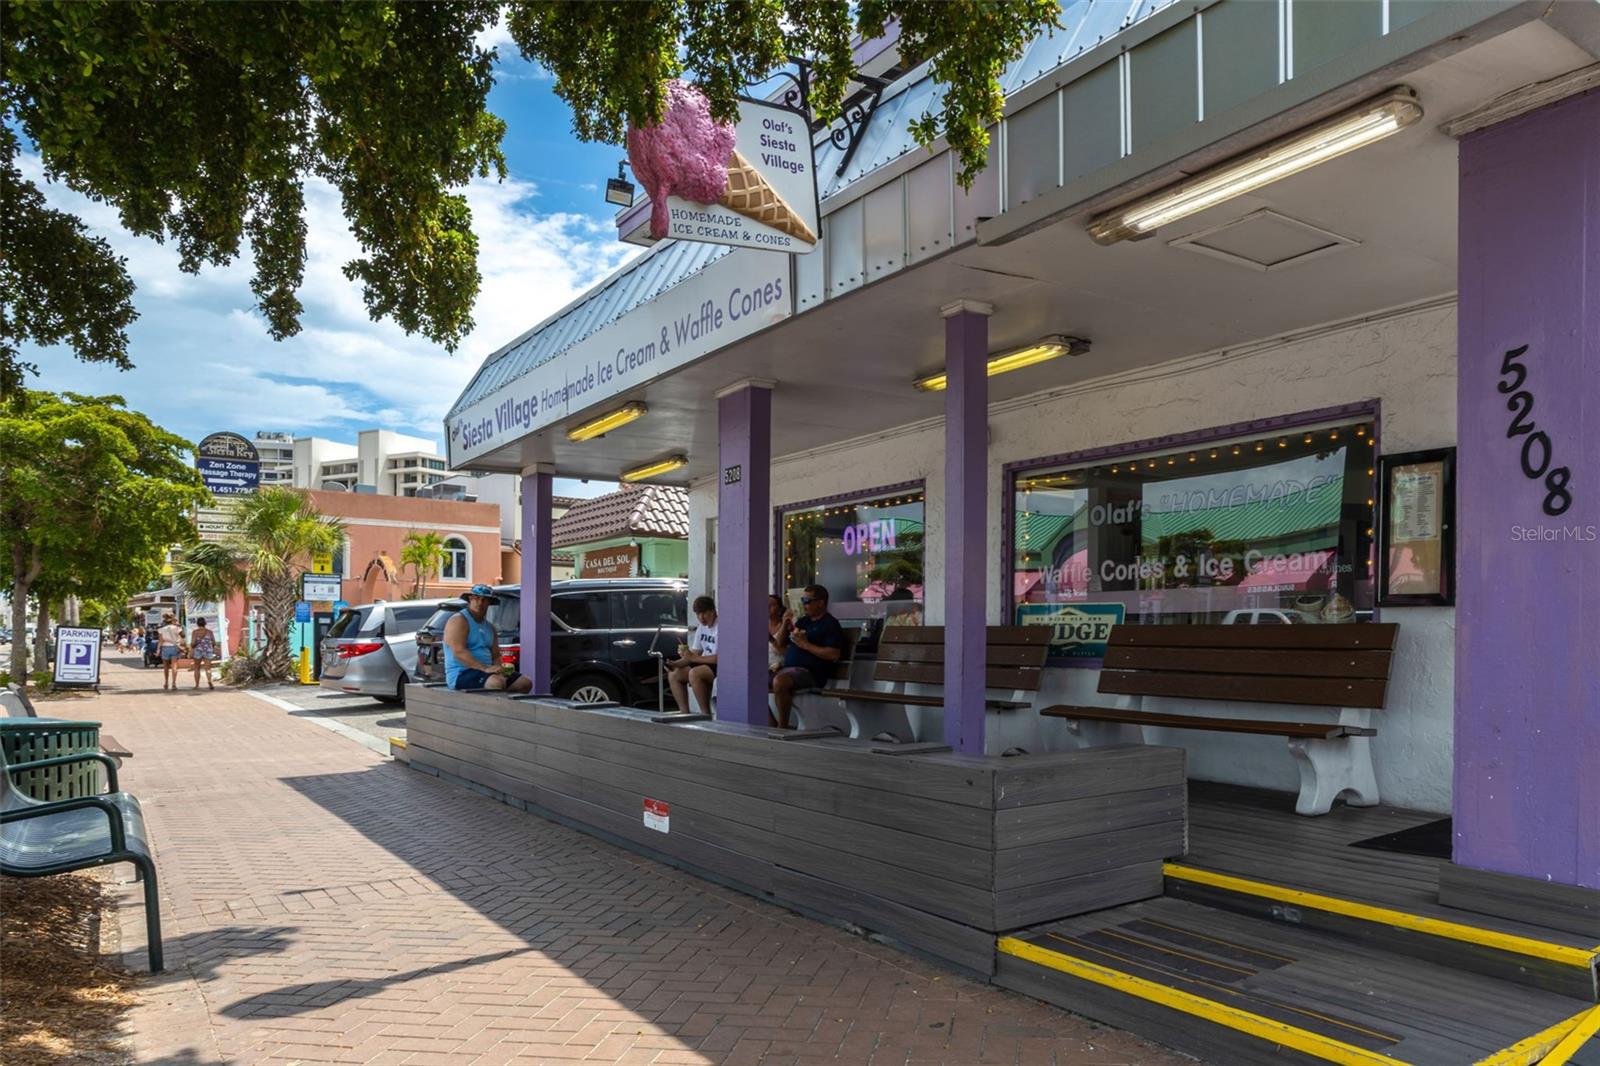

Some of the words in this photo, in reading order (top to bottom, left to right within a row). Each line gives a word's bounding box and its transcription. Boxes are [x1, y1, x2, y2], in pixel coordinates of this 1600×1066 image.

[762, 118, 793, 135] Olaf's
[760, 134, 796, 152] Siesta
[761, 153, 804, 174] Village
[671, 208, 742, 227] HOMEMADE
[673, 223, 693, 235] ICE
[697, 226, 739, 240] CREAM
[742, 231, 751, 241] &
[755, 233, 791, 247] CONES
[463, 417, 493, 450] Siesta
[495, 394, 538, 433] Village
[541, 373, 594, 413] Homemade
[597, 360, 613, 385] Ice
[616, 341, 656, 376] Cream
[659, 326, 671, 356] &
[674, 301, 723, 345] Waffle
[728, 277, 783, 322] Cones
[1497, 344, 1572, 516] 5208
[208, 446, 235, 457] Siesta
[236, 446, 254, 460] Key
[209, 460, 225, 469] Zen
[226, 462, 247, 471] Zone
[229, 470, 257, 480] Therapy
[725, 467, 740, 483] 5208
[1090, 501, 1151, 527] Olaf's
[843, 518, 897, 556] OPEN
[585, 558, 602, 569] CASA
[602, 556, 616, 566] DEL
[616, 554, 631, 565] SOL
[1038, 564, 1092, 584] Waffle
[1101, 558, 1165, 583] Cones
[1174, 554, 1189, 578] &
[1199, 552, 1233, 576] Ice
[1244, 549, 1328, 573] Cream
[61, 629, 98, 639] PARKING
[1029, 623, 1109, 640] DGE
[69, 644, 87, 664] P
